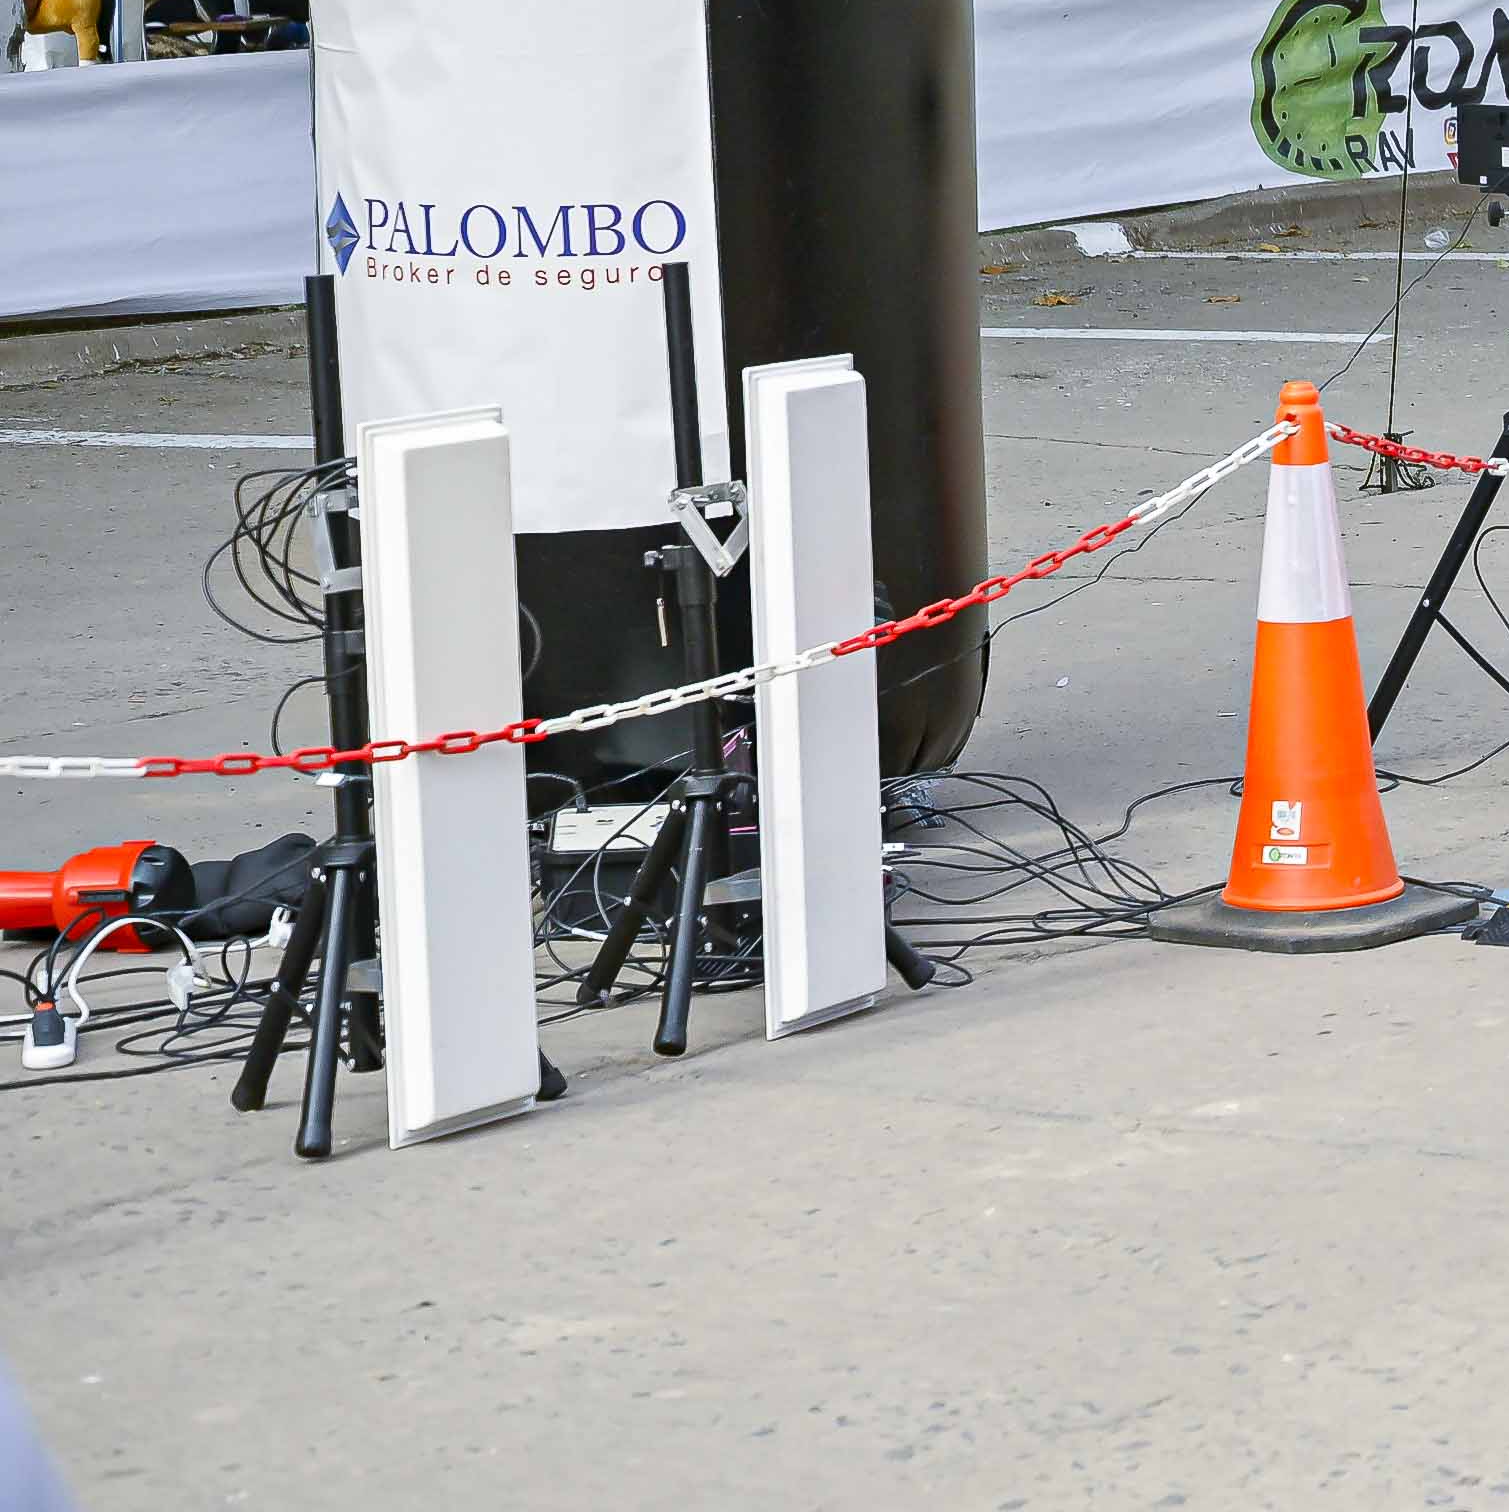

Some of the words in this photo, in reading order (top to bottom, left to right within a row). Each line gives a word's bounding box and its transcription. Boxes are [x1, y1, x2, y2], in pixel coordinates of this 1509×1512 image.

[363, 199, 687, 259] PALOMBO
[366, 256, 455, 285] Broker
[475, 264, 512, 286] de
[535, 264, 664, 291] seguro
